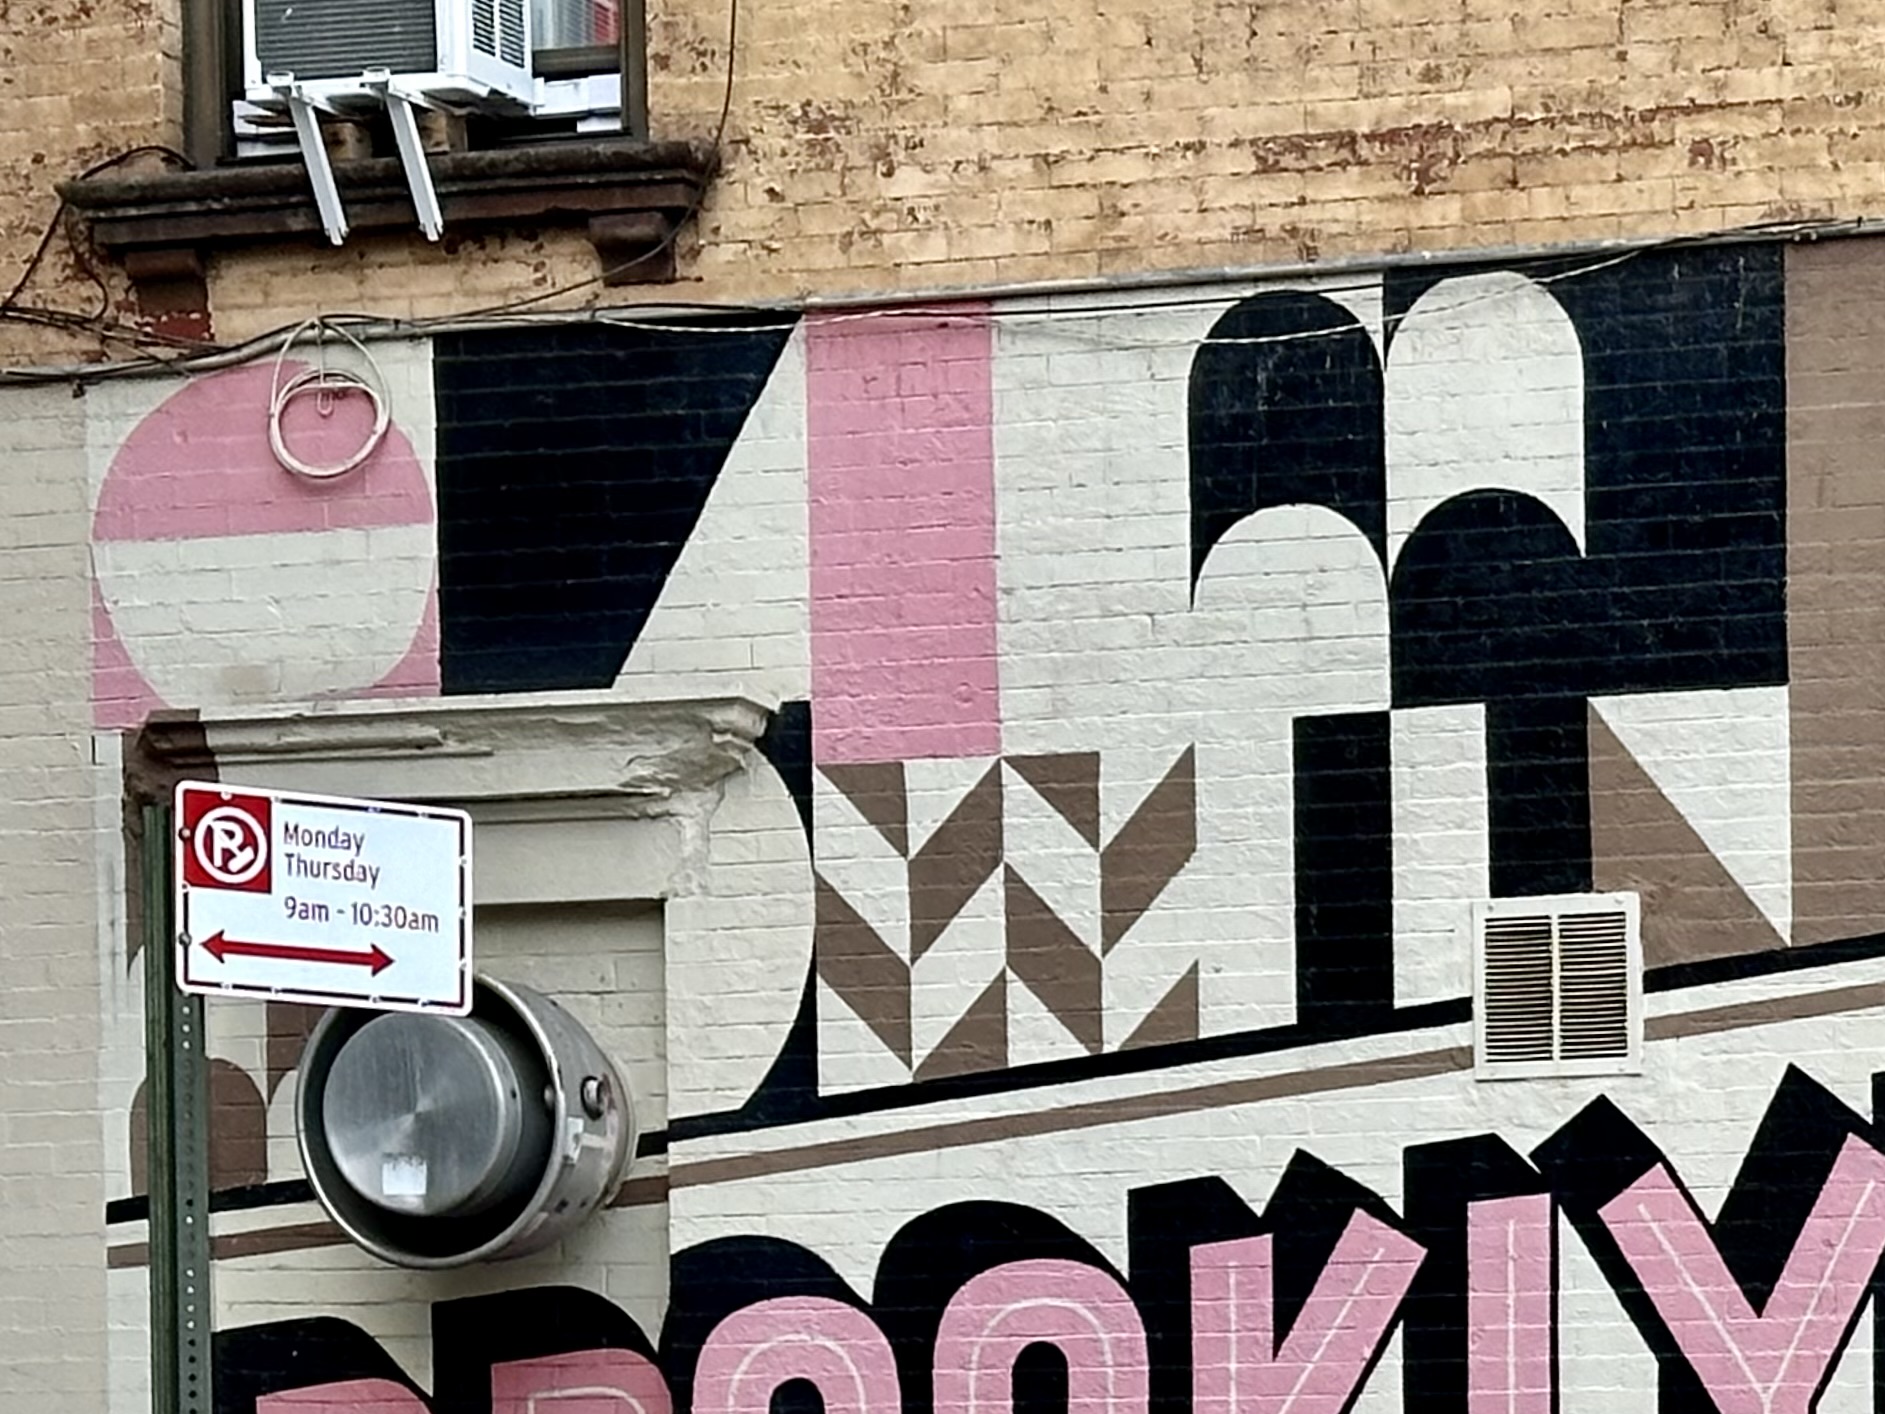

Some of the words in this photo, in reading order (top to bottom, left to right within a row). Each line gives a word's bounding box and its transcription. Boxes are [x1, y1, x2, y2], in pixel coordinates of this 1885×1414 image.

[284, 821, 366, 857] Monday
[284, 852, 381, 890] Thursday
[284, 895, 330, 923] 9am
[350, 901, 440, 934] 10:30am
